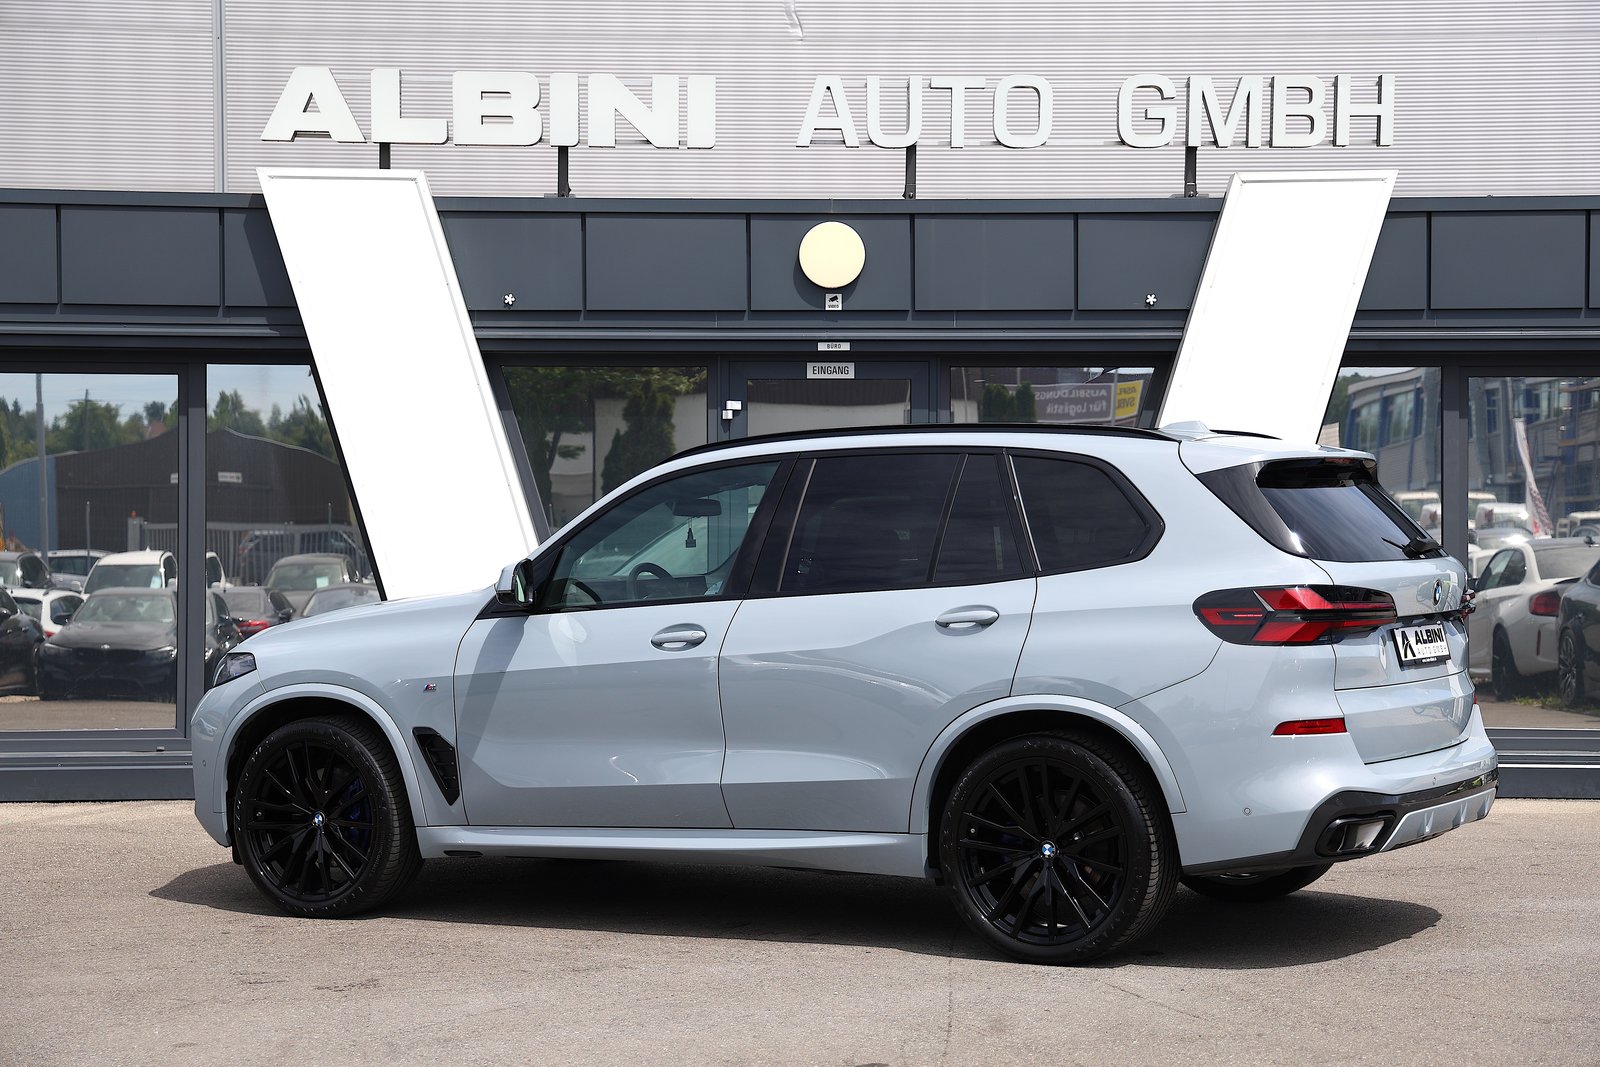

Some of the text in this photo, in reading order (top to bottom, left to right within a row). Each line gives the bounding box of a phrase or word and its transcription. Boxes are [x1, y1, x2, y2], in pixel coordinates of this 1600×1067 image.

[260, 66, 1395, 149] ALBINI AUTO GMBH
[812, 365, 849, 375] EINGANG
[1415, 628, 1444, 645] ALBINI
